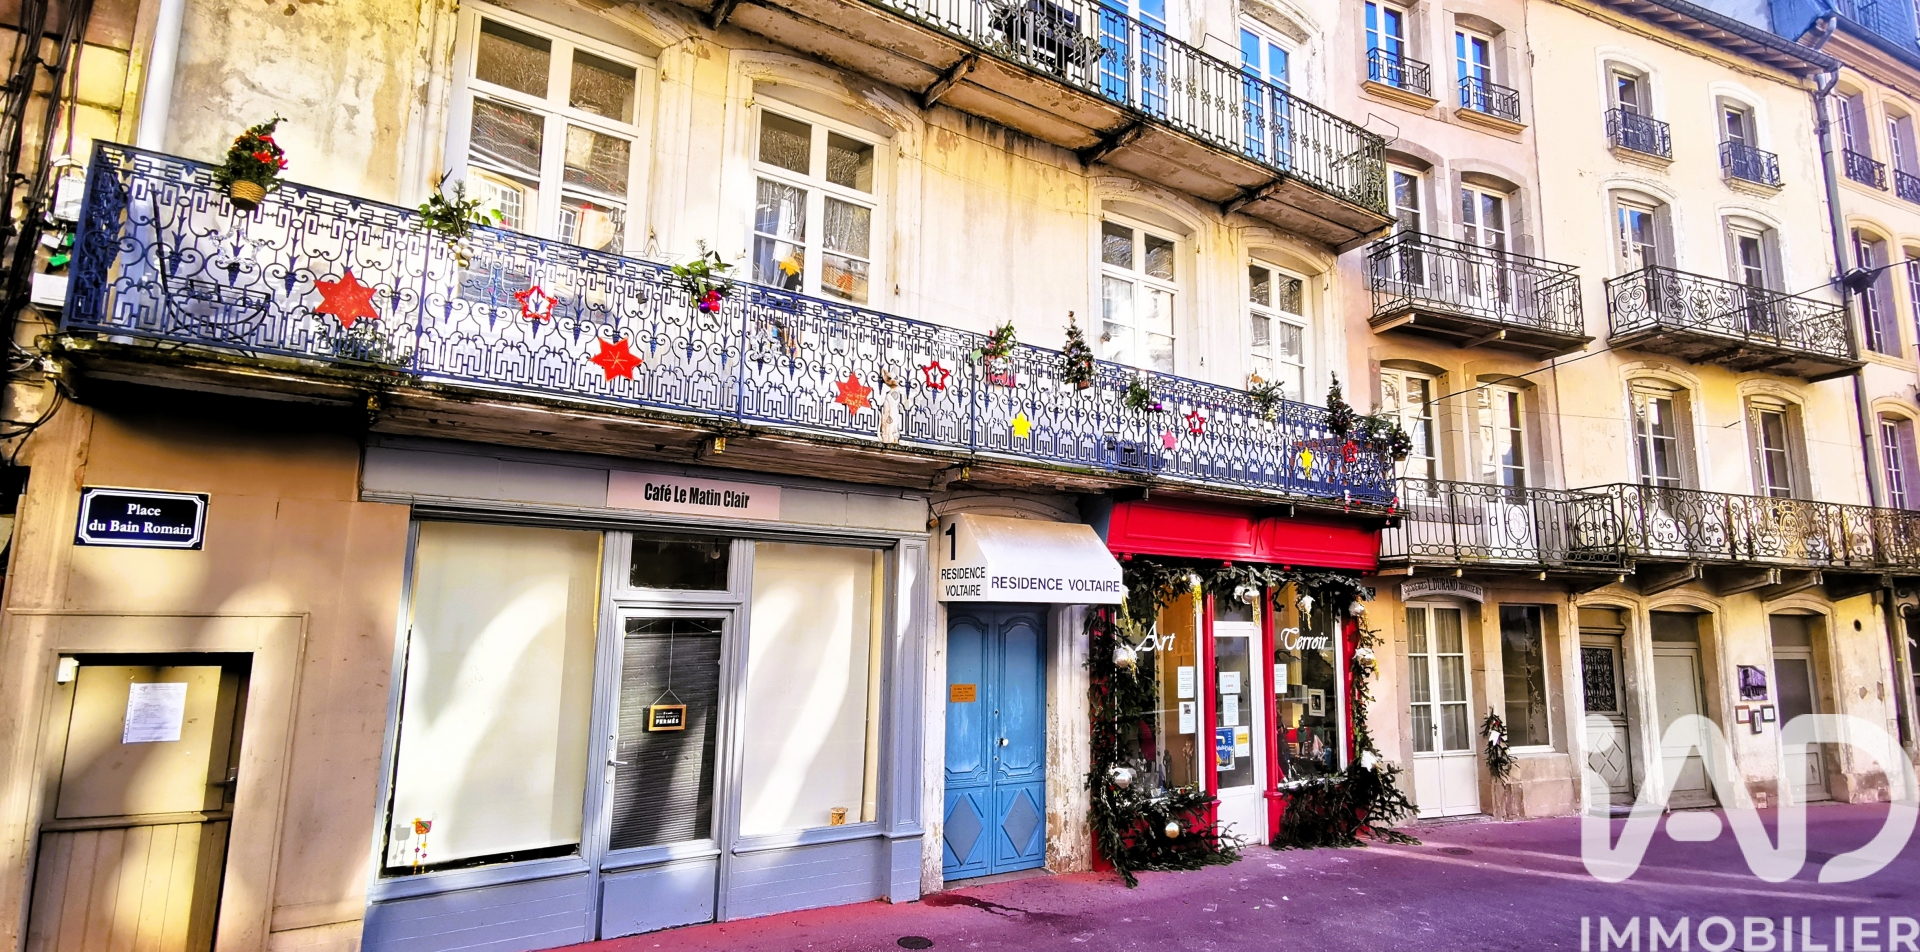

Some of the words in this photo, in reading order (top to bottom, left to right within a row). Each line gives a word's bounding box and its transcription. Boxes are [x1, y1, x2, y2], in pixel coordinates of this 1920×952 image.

[644, 482, 672, 502] Café
[673, 485, 687, 504] Le
[689, 486, 721, 507] Matin
[723, 490, 750, 509] Clair
[127, 503, 162, 516] Place
[88, 519, 107, 532] du
[109, 520, 140, 533] Bain
[143, 521, 192, 535] Romain
[945, 522, 957, 561] 1
[941, 566, 986, 581] RESIDENCE
[945, 584, 981, 597] VOLTAIRE
[991, 576, 1063, 591] RESIDENCE
[1068, 578, 1120, 593] VOLTAIRE
[1135, 620, 1176, 652] Art
[1280, 626, 1329, 651] Terroir
